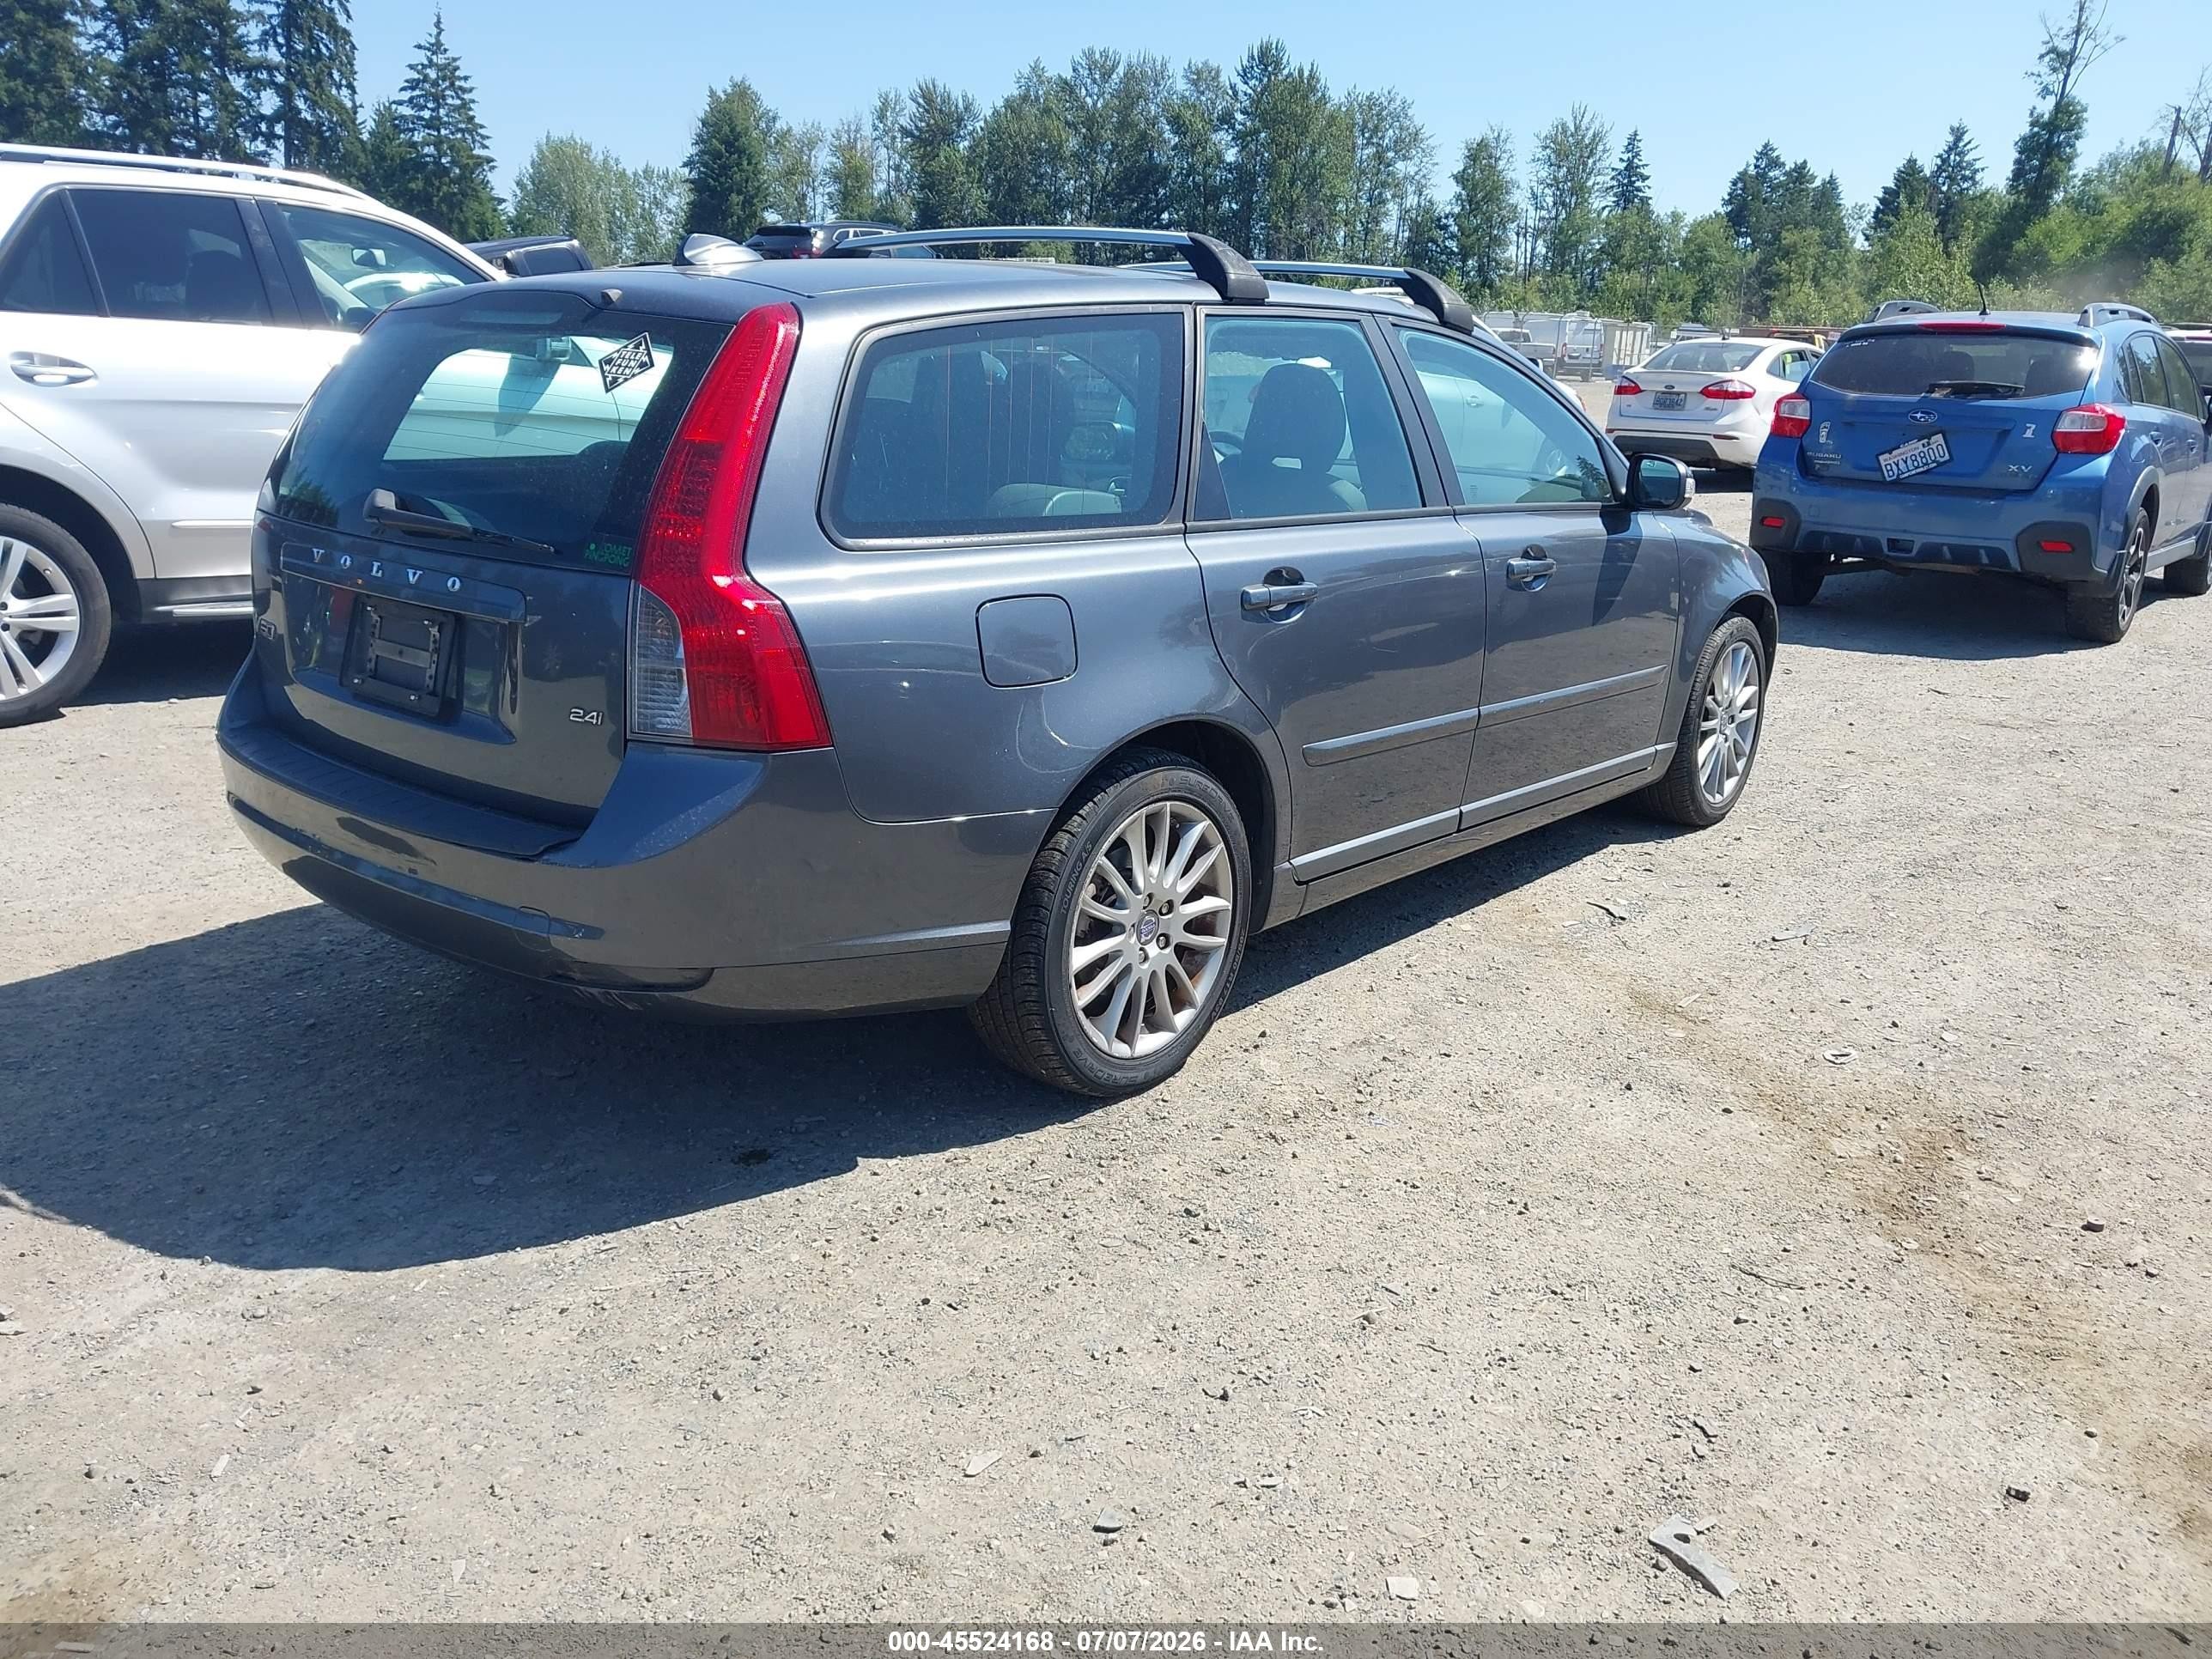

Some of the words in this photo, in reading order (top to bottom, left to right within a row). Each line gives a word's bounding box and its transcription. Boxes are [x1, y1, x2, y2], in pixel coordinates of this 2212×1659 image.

[615, 358, 638, 368] FUN
[620, 350, 643, 360] TELE
[610, 366, 633, 375] KEN
[1884, 443, 1946, 478] BXY8800
[312, 548, 461, 592] VOLVO
[1060, 860, 1083, 915] TOURING
